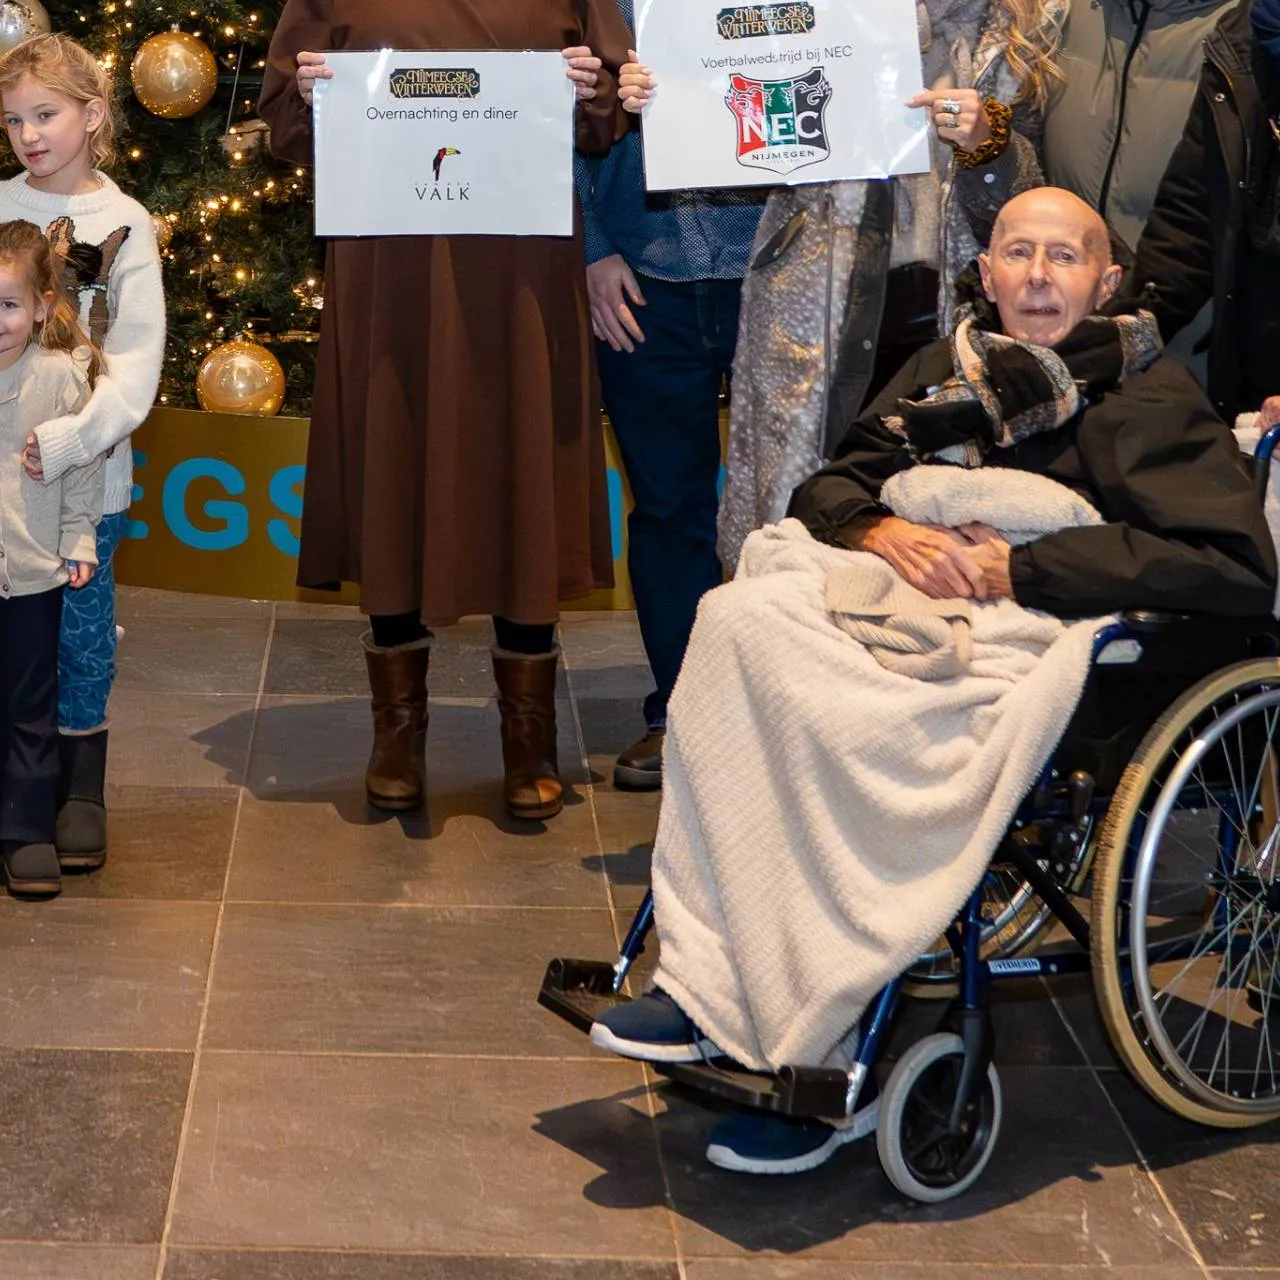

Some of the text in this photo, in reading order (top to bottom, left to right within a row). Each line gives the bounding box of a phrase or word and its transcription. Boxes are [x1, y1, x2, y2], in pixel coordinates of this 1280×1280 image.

[719, 17, 809, 39] WINTERWEKEN
[701, 45, 853, 69] Voetbalwedstrijd bij NEC
[407, 69, 476, 84] NIJMEEGSE
[391, 80, 474, 97] WINTERWEKEN
[366, 106, 519, 122] Overnachting en diner
[743, 111, 823, 143] NEC
[752, 150, 815, 161] NIJMEGEN
[414, 186, 470, 200] VALK
